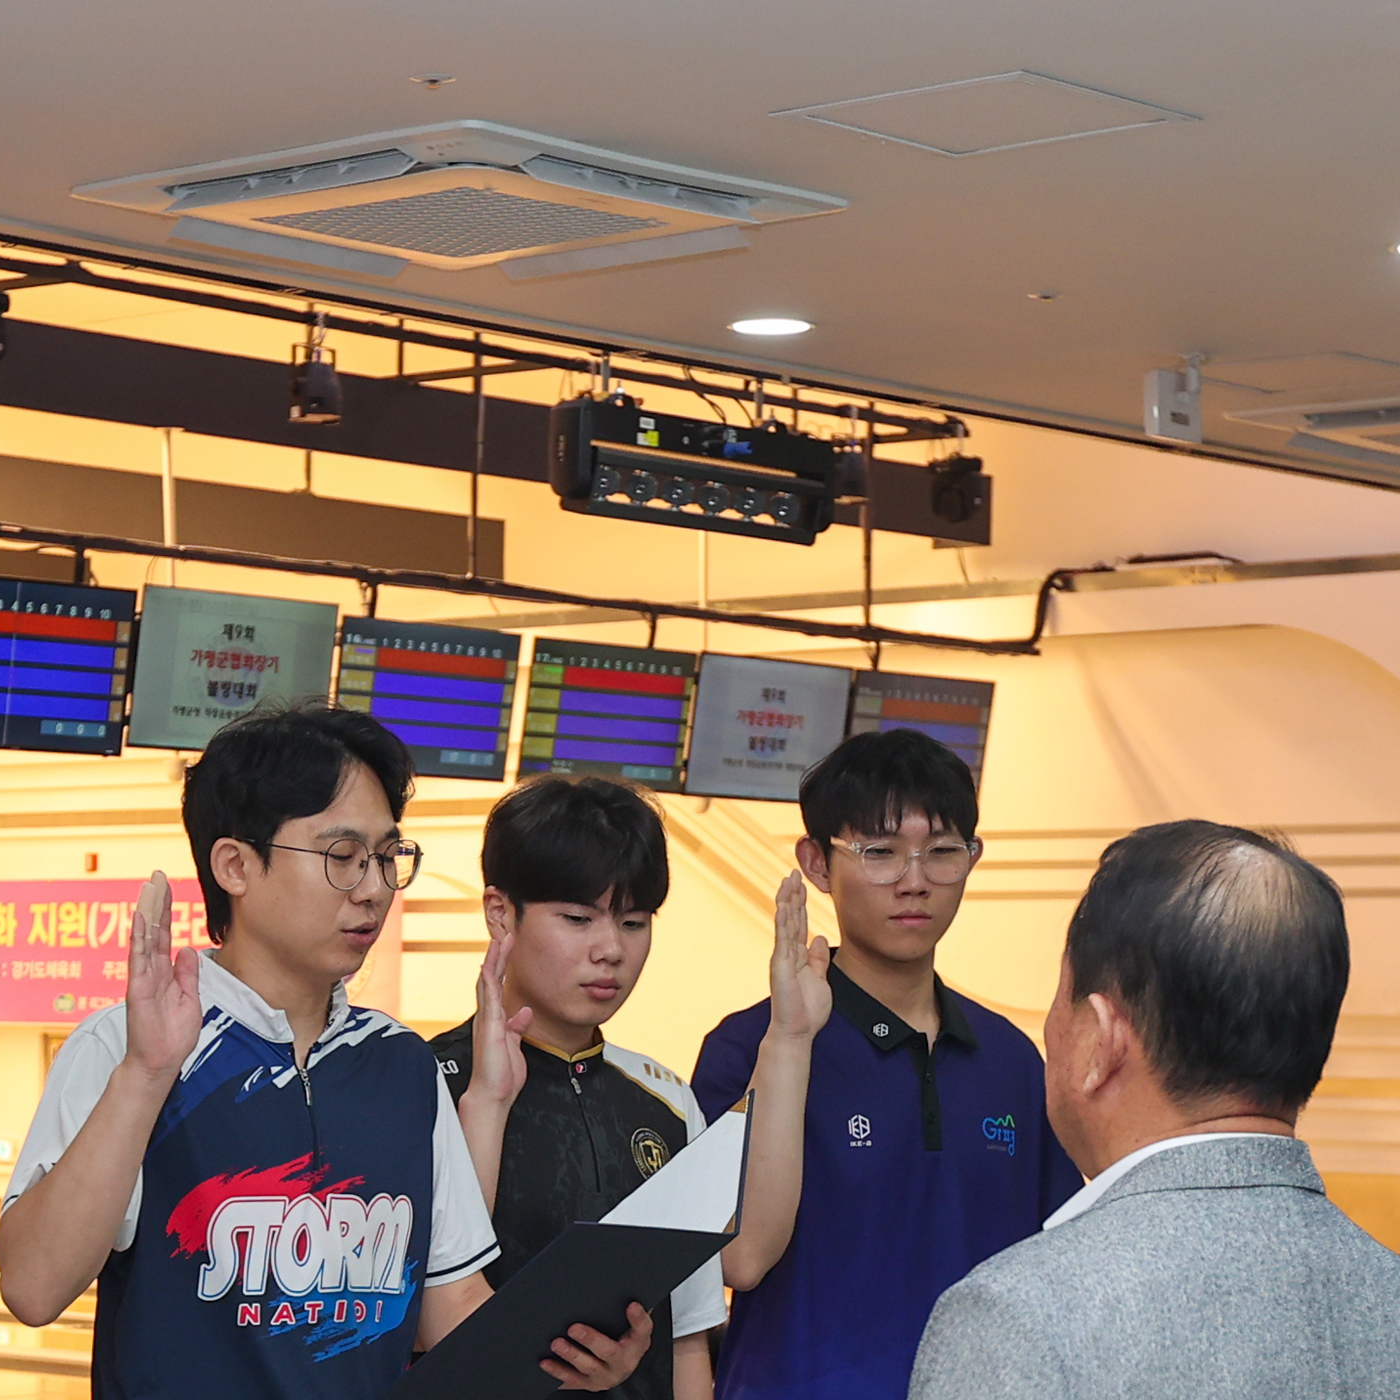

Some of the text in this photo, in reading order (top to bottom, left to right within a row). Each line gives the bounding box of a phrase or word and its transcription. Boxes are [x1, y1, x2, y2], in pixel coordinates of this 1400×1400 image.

[10, 600, 19, 611] 4
[26, 601, 34, 613] 5
[40, 603, 48, 614] 6
[55, 604, 63, 615] 7
[70, 605, 78, 617] 8
[84, 607, 93, 618] 9
[100, 608, 112, 620] 10
[222, 623, 256, 642] 제9회
[383, 638, 388, 647] 1
[394, 639, 401, 648] 2
[407, 640, 414, 649] 3
[418, 641, 426, 651] 4
[431, 642, 438, 652] 5
[443, 643, 450, 653] 6
[456, 645, 463, 654] 7
[467, 646, 475, 656] 8
[479, 647, 486, 657] 9
[492, 649, 502, 658] 10
[190, 649, 280, 673] 가평군협회장기
[207, 680, 258, 700] 볼링대회
[11, 961, 81, 980] 경기도체육회
[198, 1193, 413, 1301] STORM
[237, 1299, 383, 1326] NATIO
